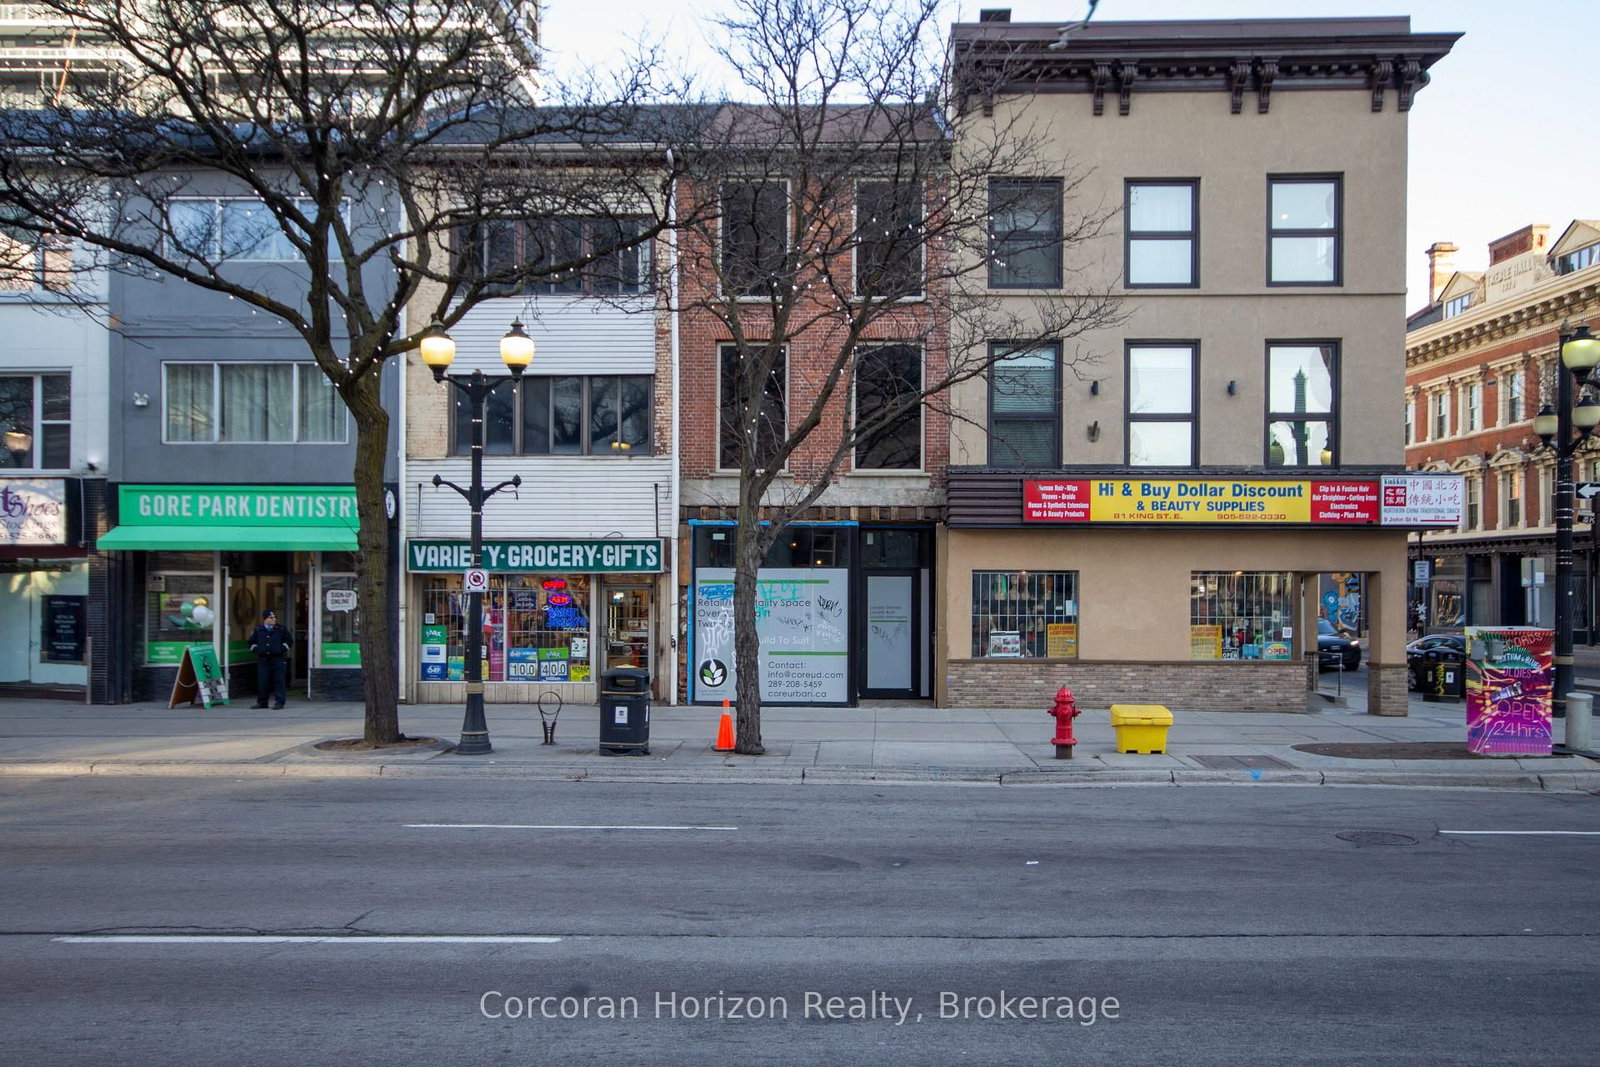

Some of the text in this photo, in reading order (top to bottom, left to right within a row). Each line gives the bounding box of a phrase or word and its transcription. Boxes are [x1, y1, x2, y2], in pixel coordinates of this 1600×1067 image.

[1098, 482, 1304, 499] Hi & Buy Dollar Discount
[139, 494, 192, 517] GORE
[198, 495, 250, 517] PARK
[1136, 501, 1265, 511] & BEAUTY SUPPLIES
[1156, 512, 1172, 520] ST.
[1319, 511, 1340, 519] Clothing
[1355, 511, 1369, 519] More
[413, 544, 657, 567] VARIEY GROCERY GIFTS
[780, 599, 811, 608] Space
[778, 636, 790, 645] To
[792, 636, 810, 645] Suit
[768, 660, 807, 669] Contact:
[767, 680, 823, 688] 289-208-5459
